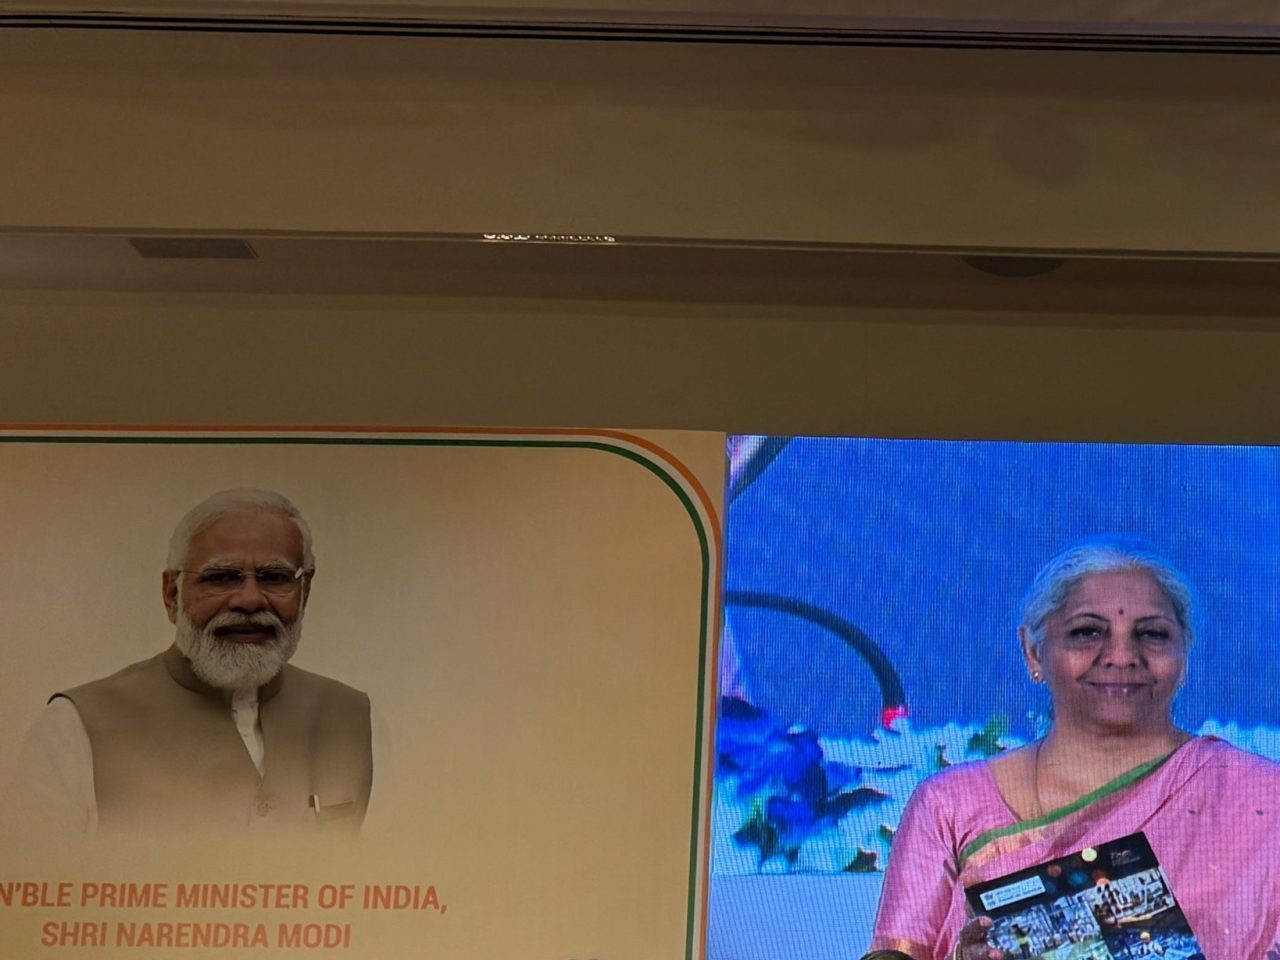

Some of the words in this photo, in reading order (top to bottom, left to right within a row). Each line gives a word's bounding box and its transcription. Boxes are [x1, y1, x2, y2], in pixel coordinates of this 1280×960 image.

[80, 883, 168, 908] PRIME
[175, 884, 310, 909] MINISTER
[318, 884, 356, 909] OF
[362, 885, 448, 915] INDIA,
[40, 921, 108, 947] SHRI
[115, 922, 270, 948] NARENDRA
[277, 923, 352, 948] MODI
